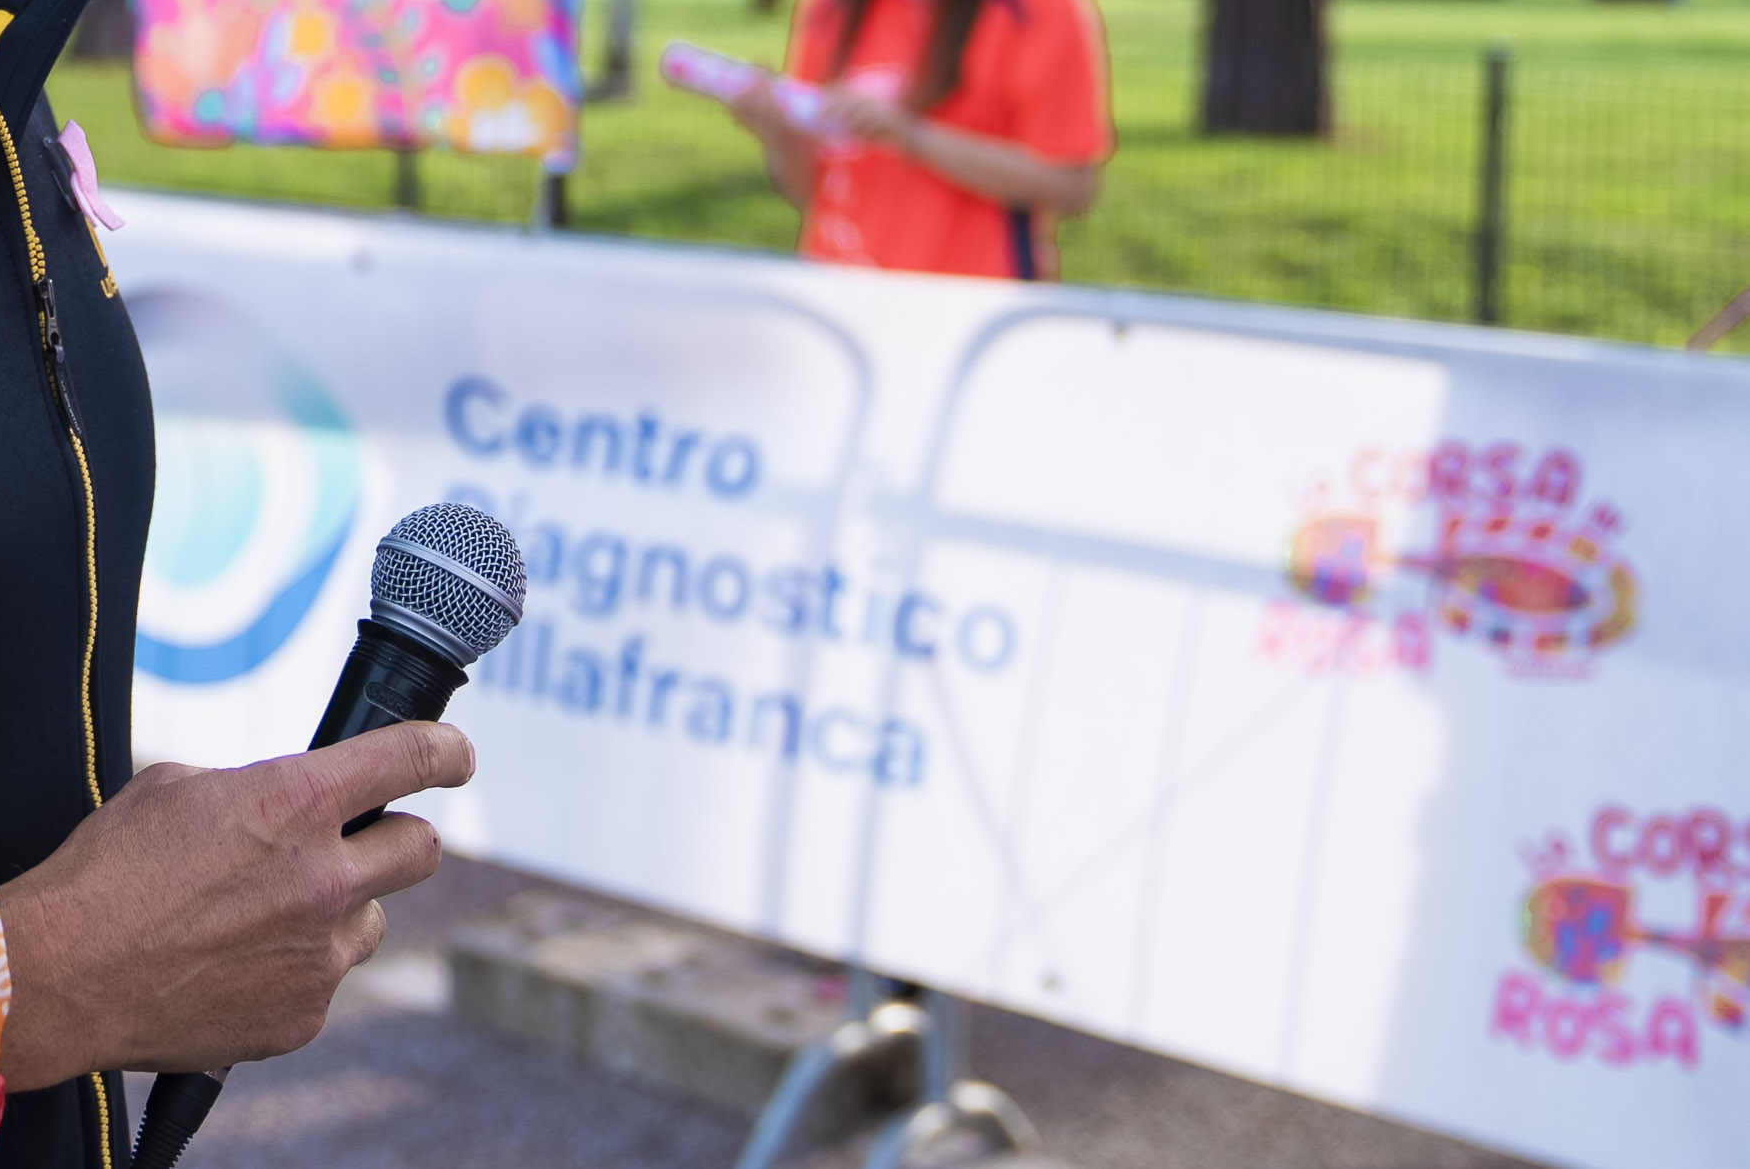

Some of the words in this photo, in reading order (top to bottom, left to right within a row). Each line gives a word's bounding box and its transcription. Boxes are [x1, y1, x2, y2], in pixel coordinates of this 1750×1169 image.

[442, 373, 764, 501] Centro
[1348, 437, 1582, 507] CORSA
[442, 479, 1018, 675] agnostico
[1590, 805, 1750, 879] COR
[1488, 971, 1702, 1071] ROSA
